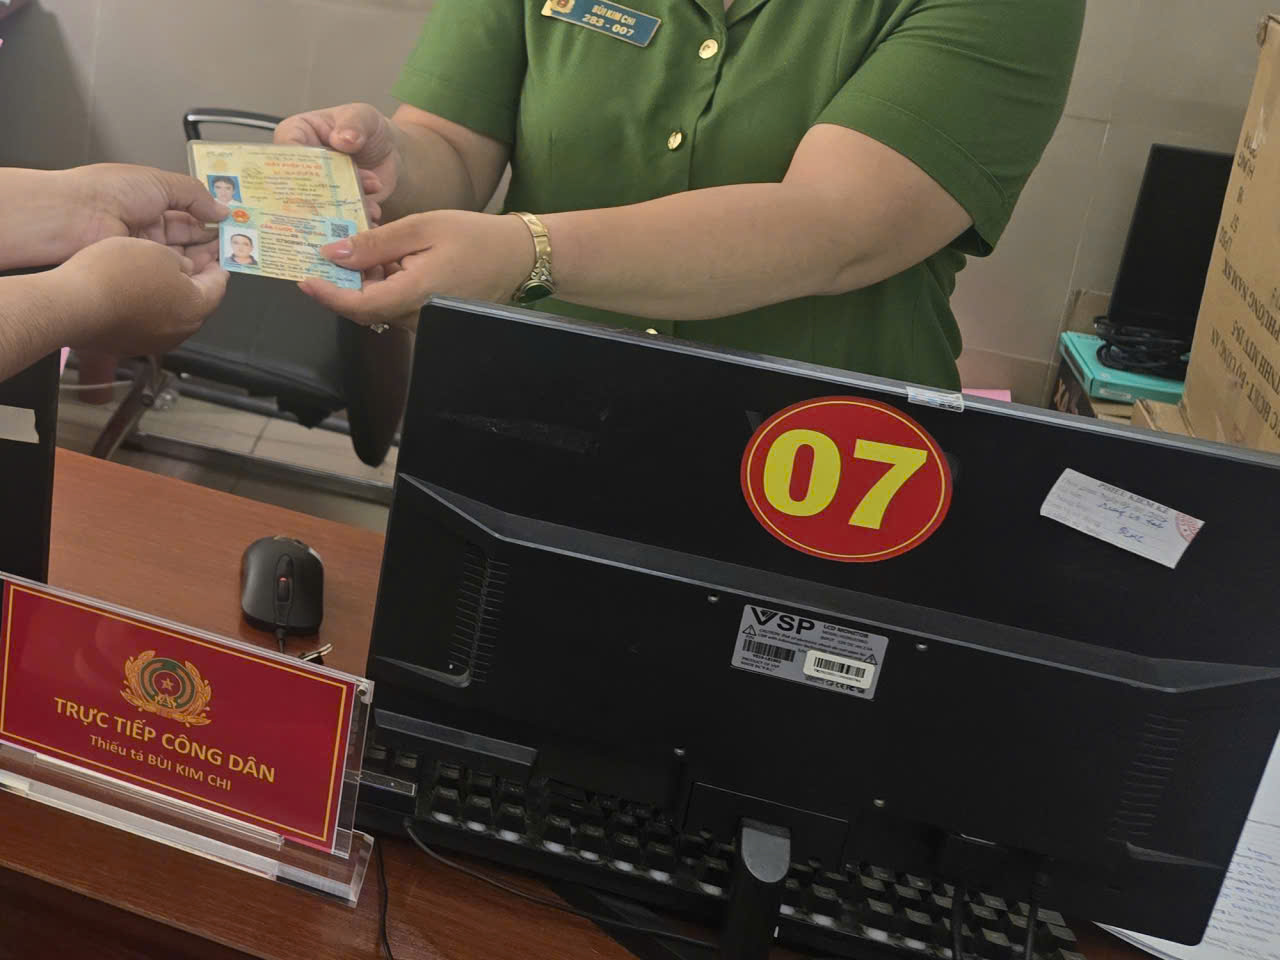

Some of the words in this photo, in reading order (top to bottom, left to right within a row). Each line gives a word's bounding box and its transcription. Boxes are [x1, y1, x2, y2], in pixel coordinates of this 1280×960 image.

[621, 15, 636, 25] CHI
[762, 428, 928, 530] 07
[750, 606, 815, 635] VSP
[54, 696, 109, 729] TRỰC
[114, 715, 157, 743] TIẾP
[162, 732, 222, 767] CÔNG
[229, 752, 276, 784] DÂN
[89, 734, 127, 758] Thiếu
[130, 746, 144, 763] tá
[148, 749, 173, 772] BÙI
[176, 762, 204, 782] KIM
[207, 771, 232, 792] CHI
